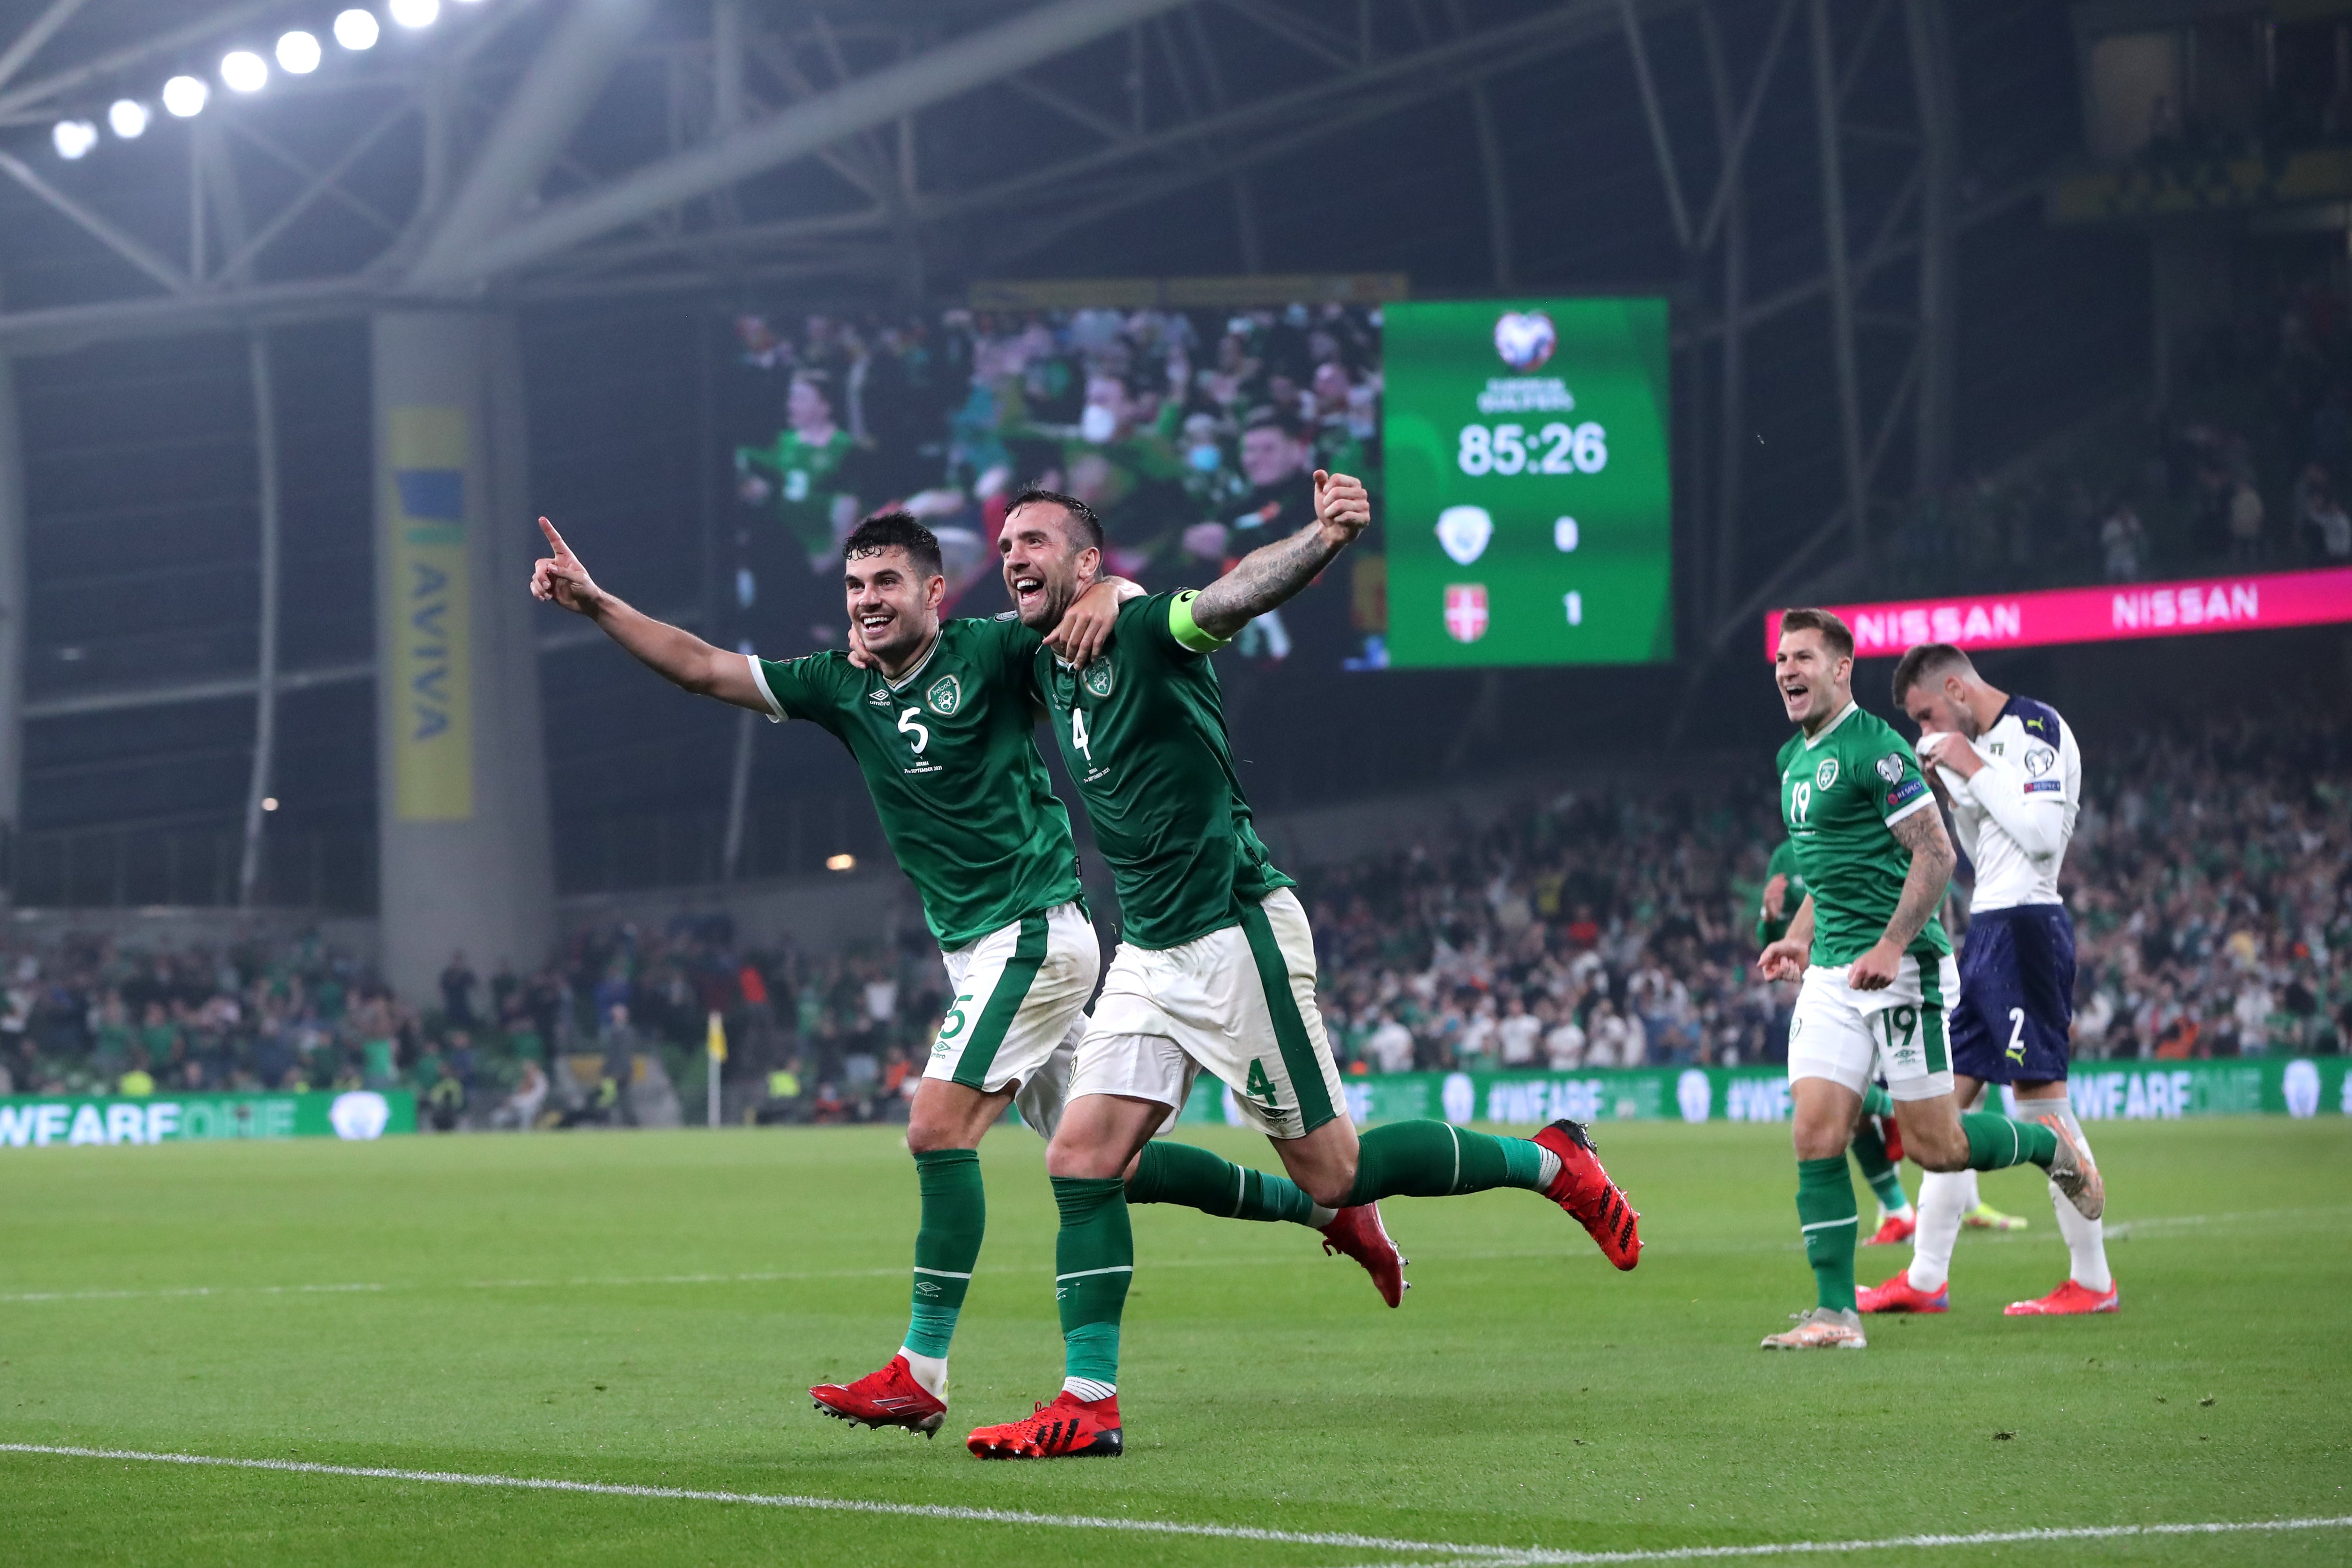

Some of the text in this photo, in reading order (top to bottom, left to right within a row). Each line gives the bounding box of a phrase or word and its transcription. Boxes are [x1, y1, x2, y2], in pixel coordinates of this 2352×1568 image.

[1458, 422, 1607, 476] 85:26
[1555, 516, 1578, 552] 0
[1563, 590, 1581, 625] 1
[1855, 603, 2020, 648] NISSAN
[2112, 584, 2259, 630] NISSAN
[410, 565, 449, 741] AVIVA
[932, 679, 951, 696] Ireland
[898, 707, 929, 754] 5
[1072, 707, 1091, 761] 4
[1790, 781, 1810, 824] 19
[940, 995, 974, 1039] 5
[1882, 1005, 1917, 1047] 19
[2008, 1008, 2025, 1049] 2
[1247, 1058, 1278, 1107] 4
